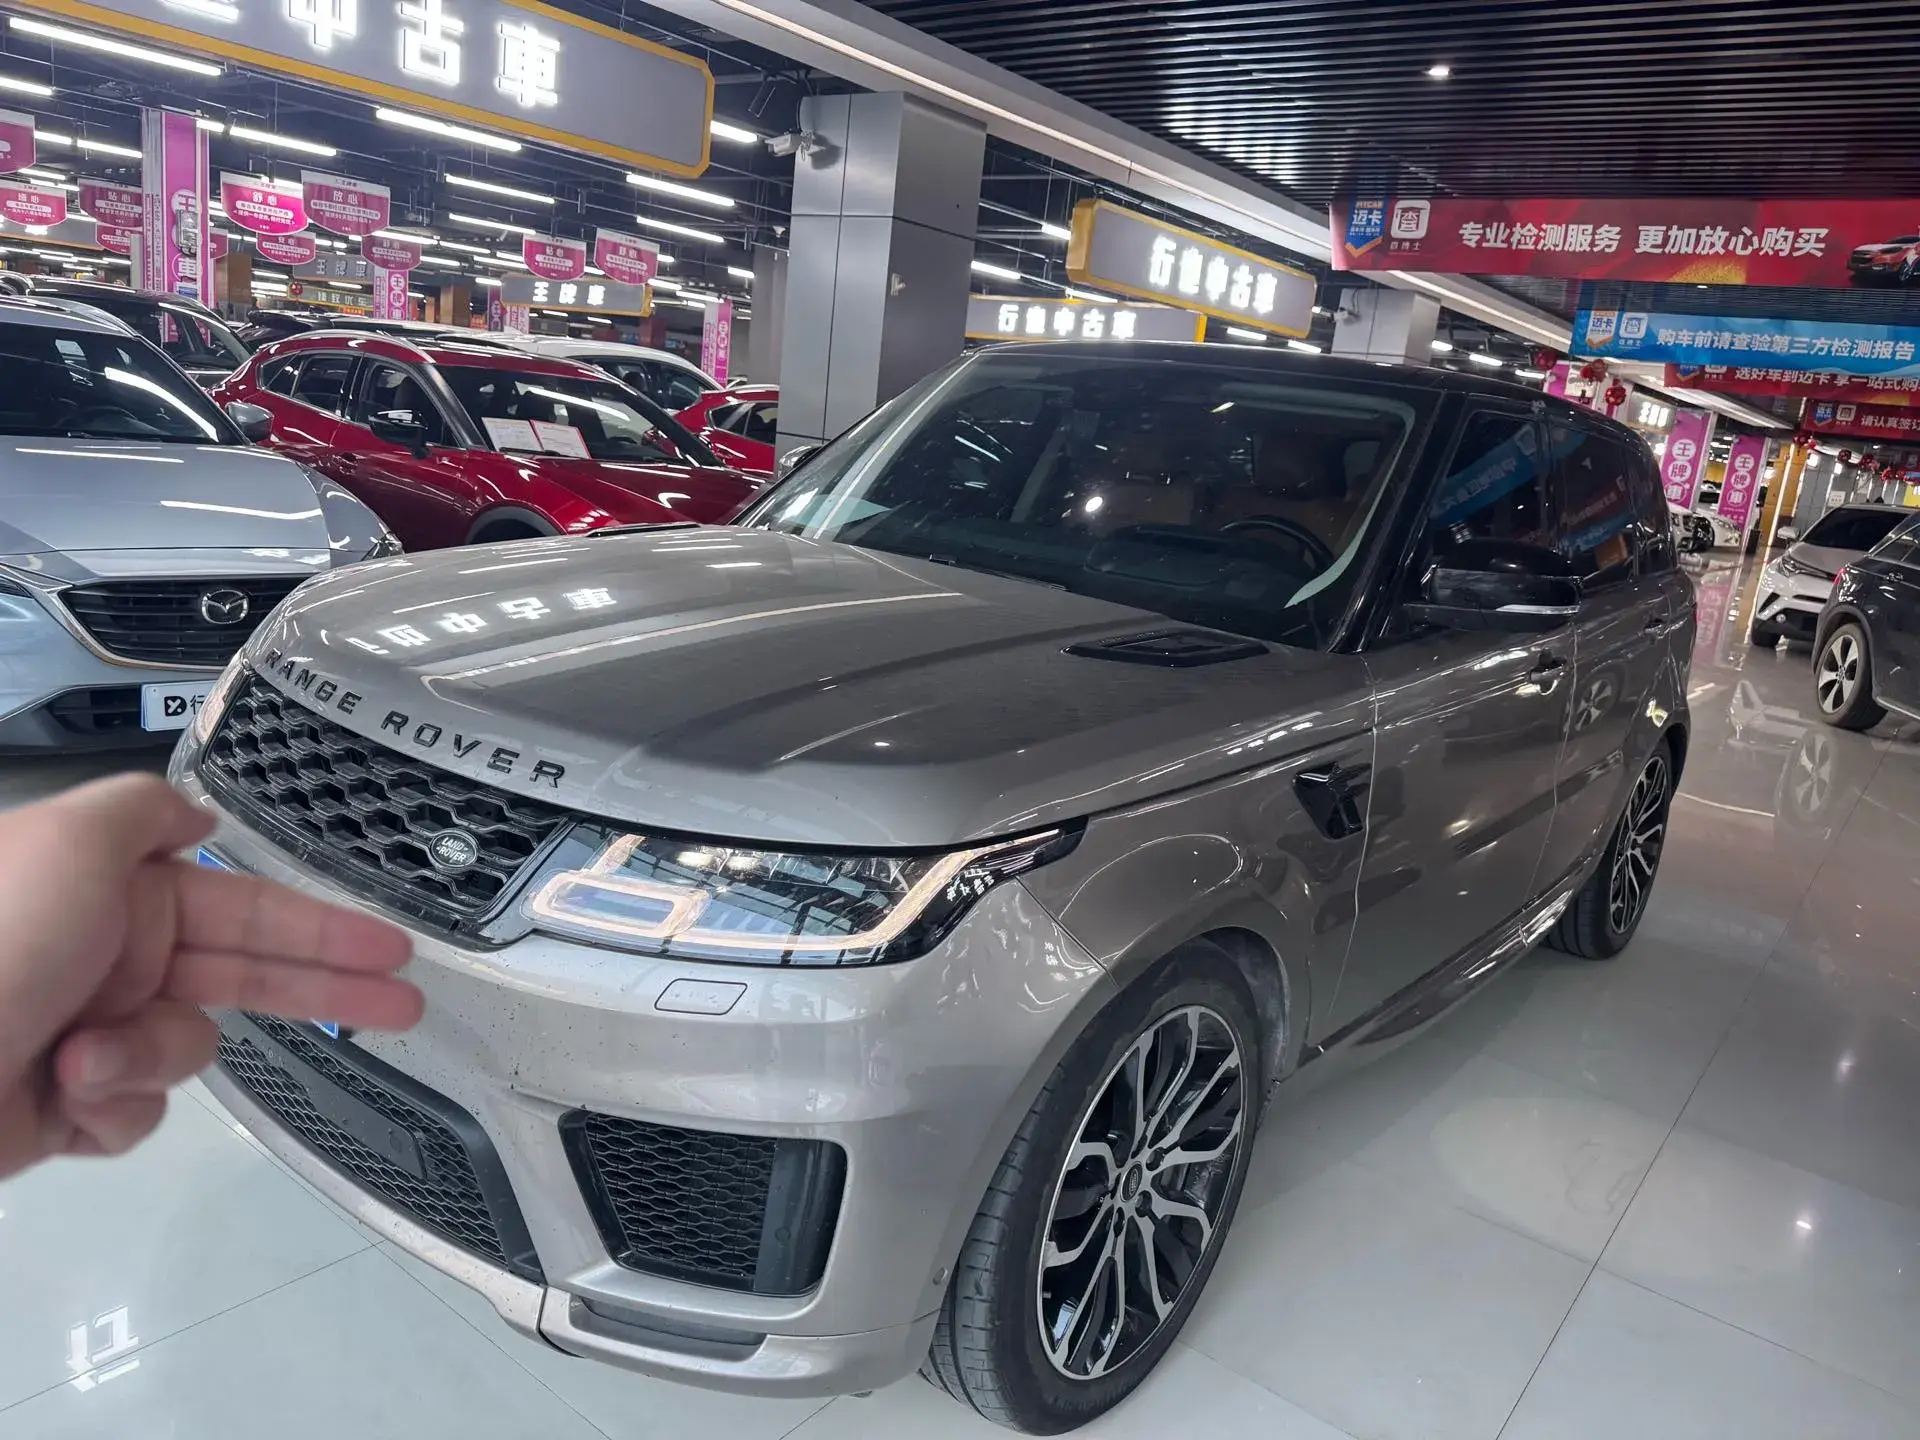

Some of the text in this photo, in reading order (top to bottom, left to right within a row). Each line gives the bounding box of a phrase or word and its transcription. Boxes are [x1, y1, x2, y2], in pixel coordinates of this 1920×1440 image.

[163, 0, 560, 105] 中古車
[1352, 209, 1383, 225] 迈卡
[1458, 222, 1830, 258] 专业检测服务 更加放心购买
[1656, 328, 1915, 361] 购车前请查验第三方检测报告
[264, 648, 566, 789] RANGE ROVER
[438, 846, 467, 862] ROVER
[441, 836, 465, 851] LAND
